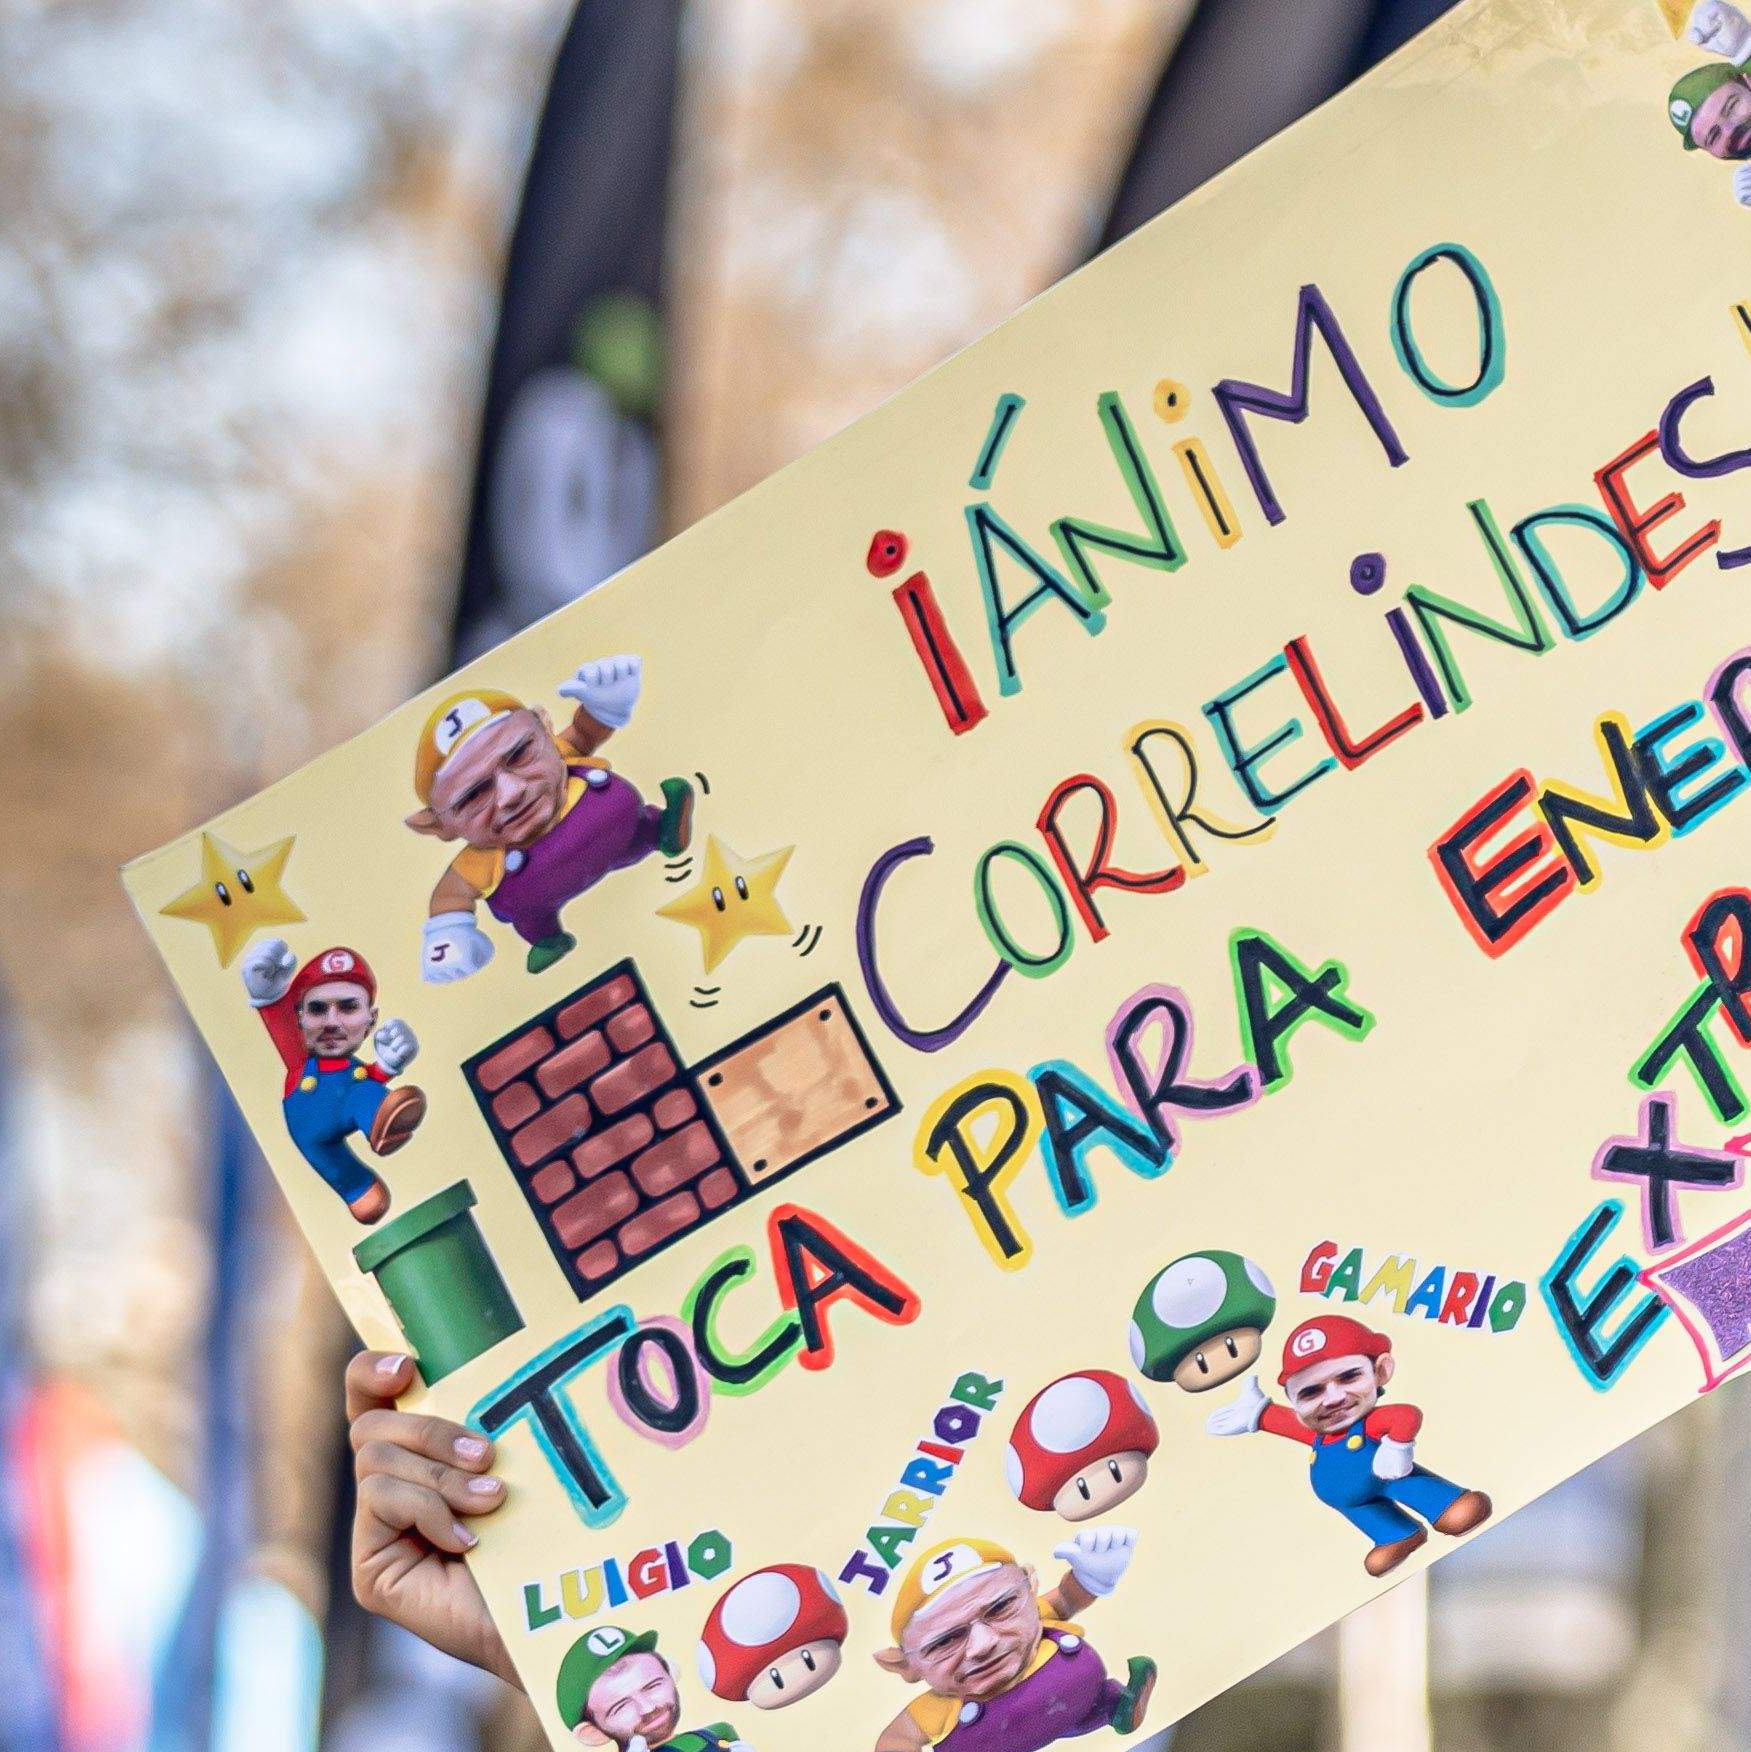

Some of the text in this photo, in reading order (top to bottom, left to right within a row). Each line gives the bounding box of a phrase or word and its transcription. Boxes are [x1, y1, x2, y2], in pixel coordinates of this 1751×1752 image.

[467, 1203, 921, 1528] TOCA
[913, 926, 1378, 1272] PARA
[1299, 1239, 1527, 1333] GAMARIO
[837, 1371, 1005, 1596] JARRIOR
[523, 1529, 733, 1632] LUIGIO
